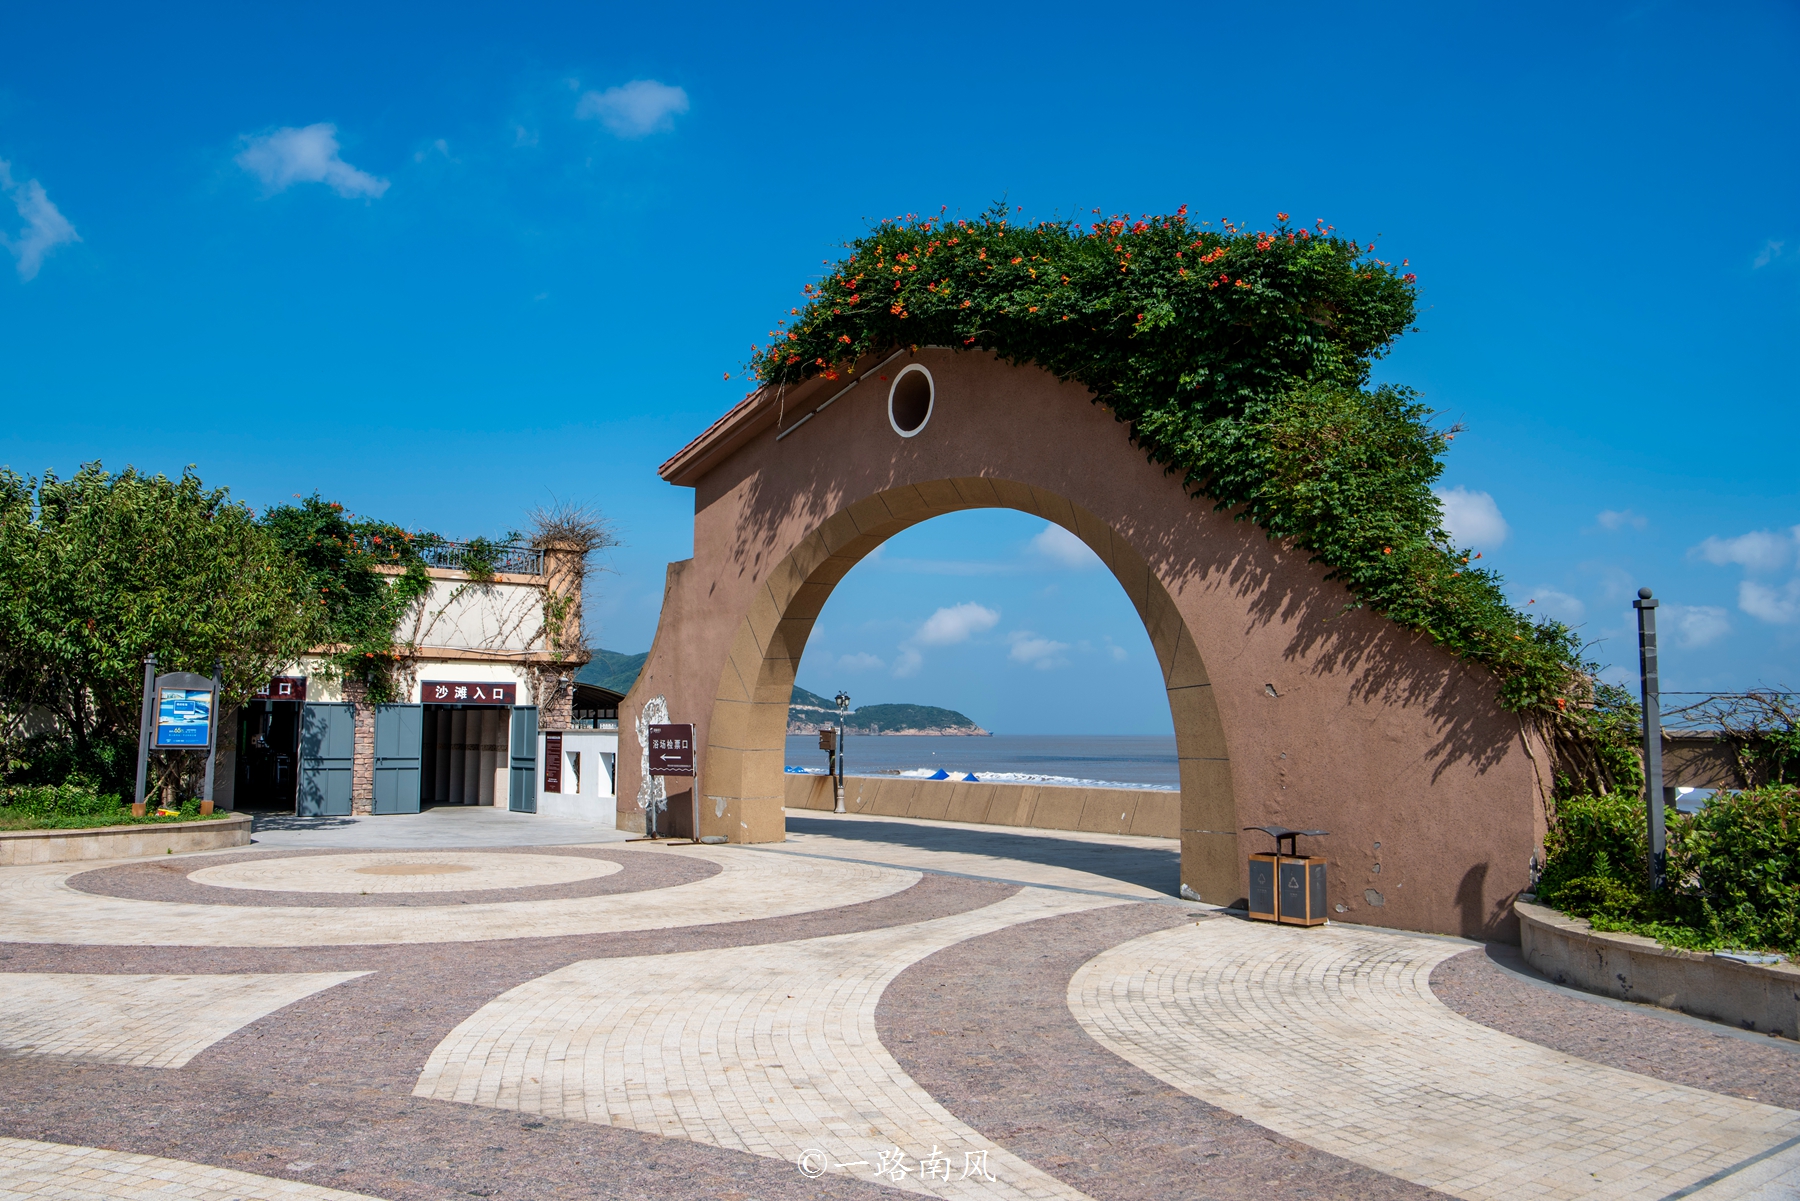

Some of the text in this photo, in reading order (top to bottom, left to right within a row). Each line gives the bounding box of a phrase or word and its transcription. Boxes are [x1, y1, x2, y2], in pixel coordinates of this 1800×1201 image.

[435, 685, 504, 700] 沙滩入口
[652, 739, 689, 750] 浴场检票口
